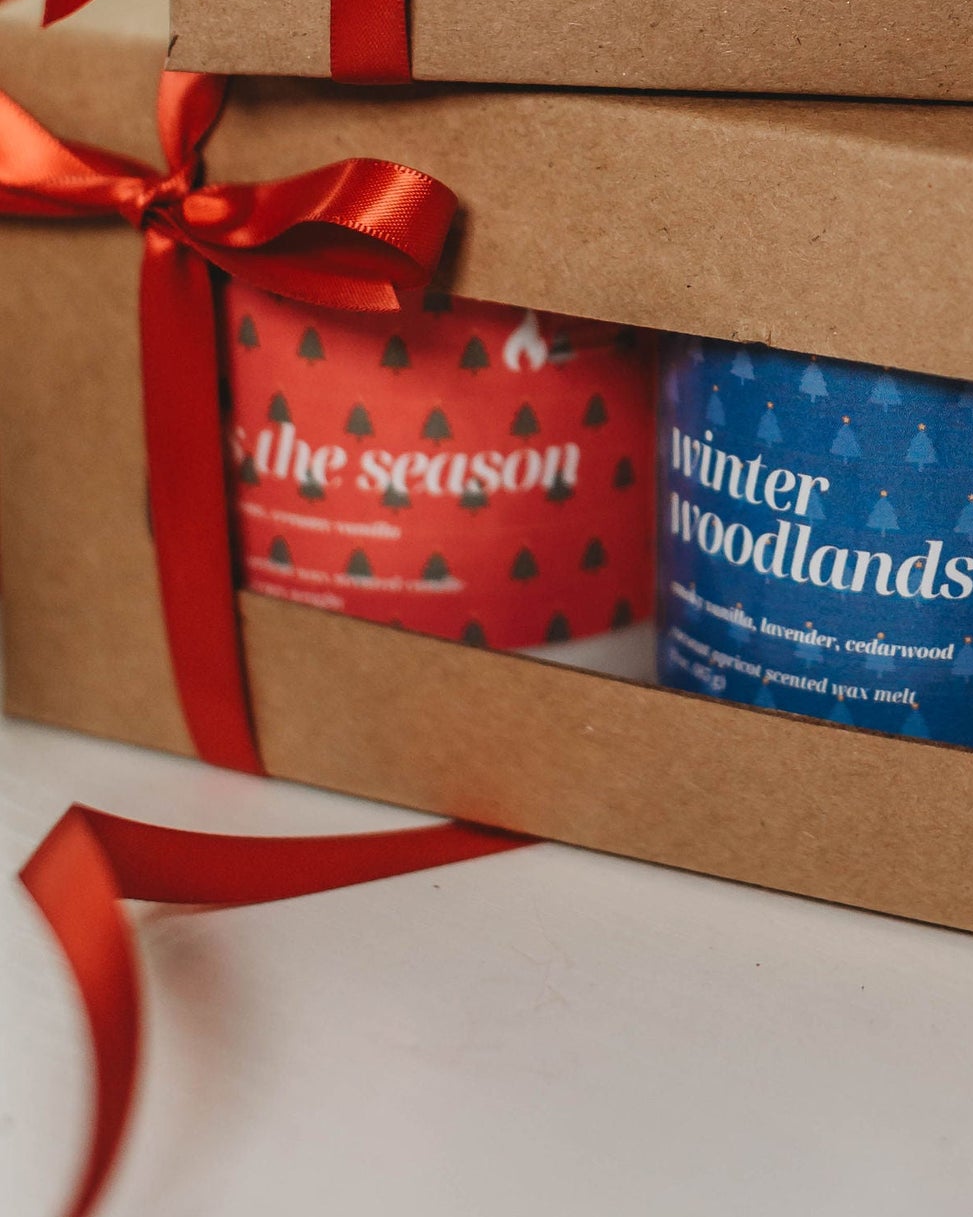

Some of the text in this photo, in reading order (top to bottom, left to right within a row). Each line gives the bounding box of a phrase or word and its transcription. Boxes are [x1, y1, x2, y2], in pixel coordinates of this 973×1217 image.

[255, 422, 348, 487] the
[359, 442, 580, 498] season
[672, 427, 829, 517] winter
[760, 617, 841, 652] lavender,
[845, 637, 954, 661] cedarwood
[763, 667, 829, 695] scented
[832, 683, 869, 701] wax
[873, 687, 917, 705] melt
